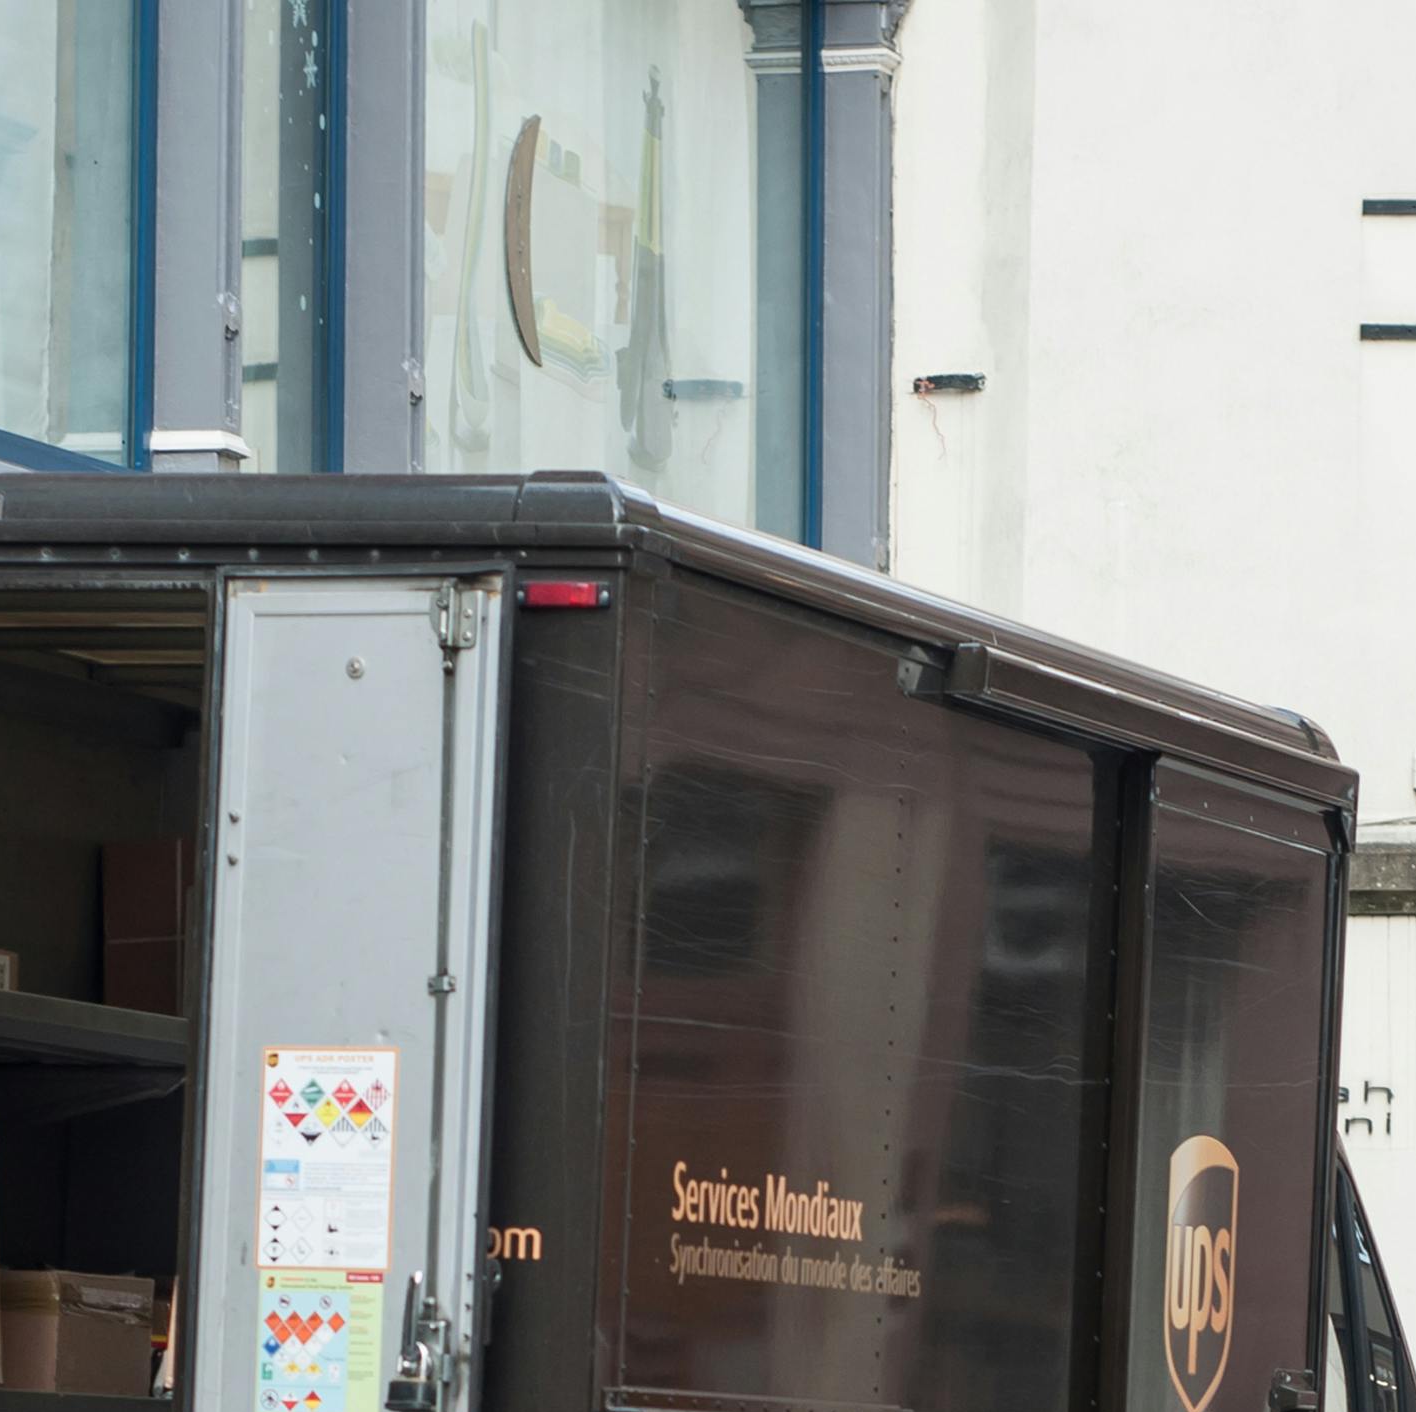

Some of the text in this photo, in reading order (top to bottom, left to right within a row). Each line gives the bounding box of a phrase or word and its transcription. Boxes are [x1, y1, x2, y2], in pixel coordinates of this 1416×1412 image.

[672, 1161, 863, 1241] Services Mondiaux
[670, 1233, 921, 1297] Synchronisation du monde des affaires
[1170, 1225, 1230, 1375] ups
